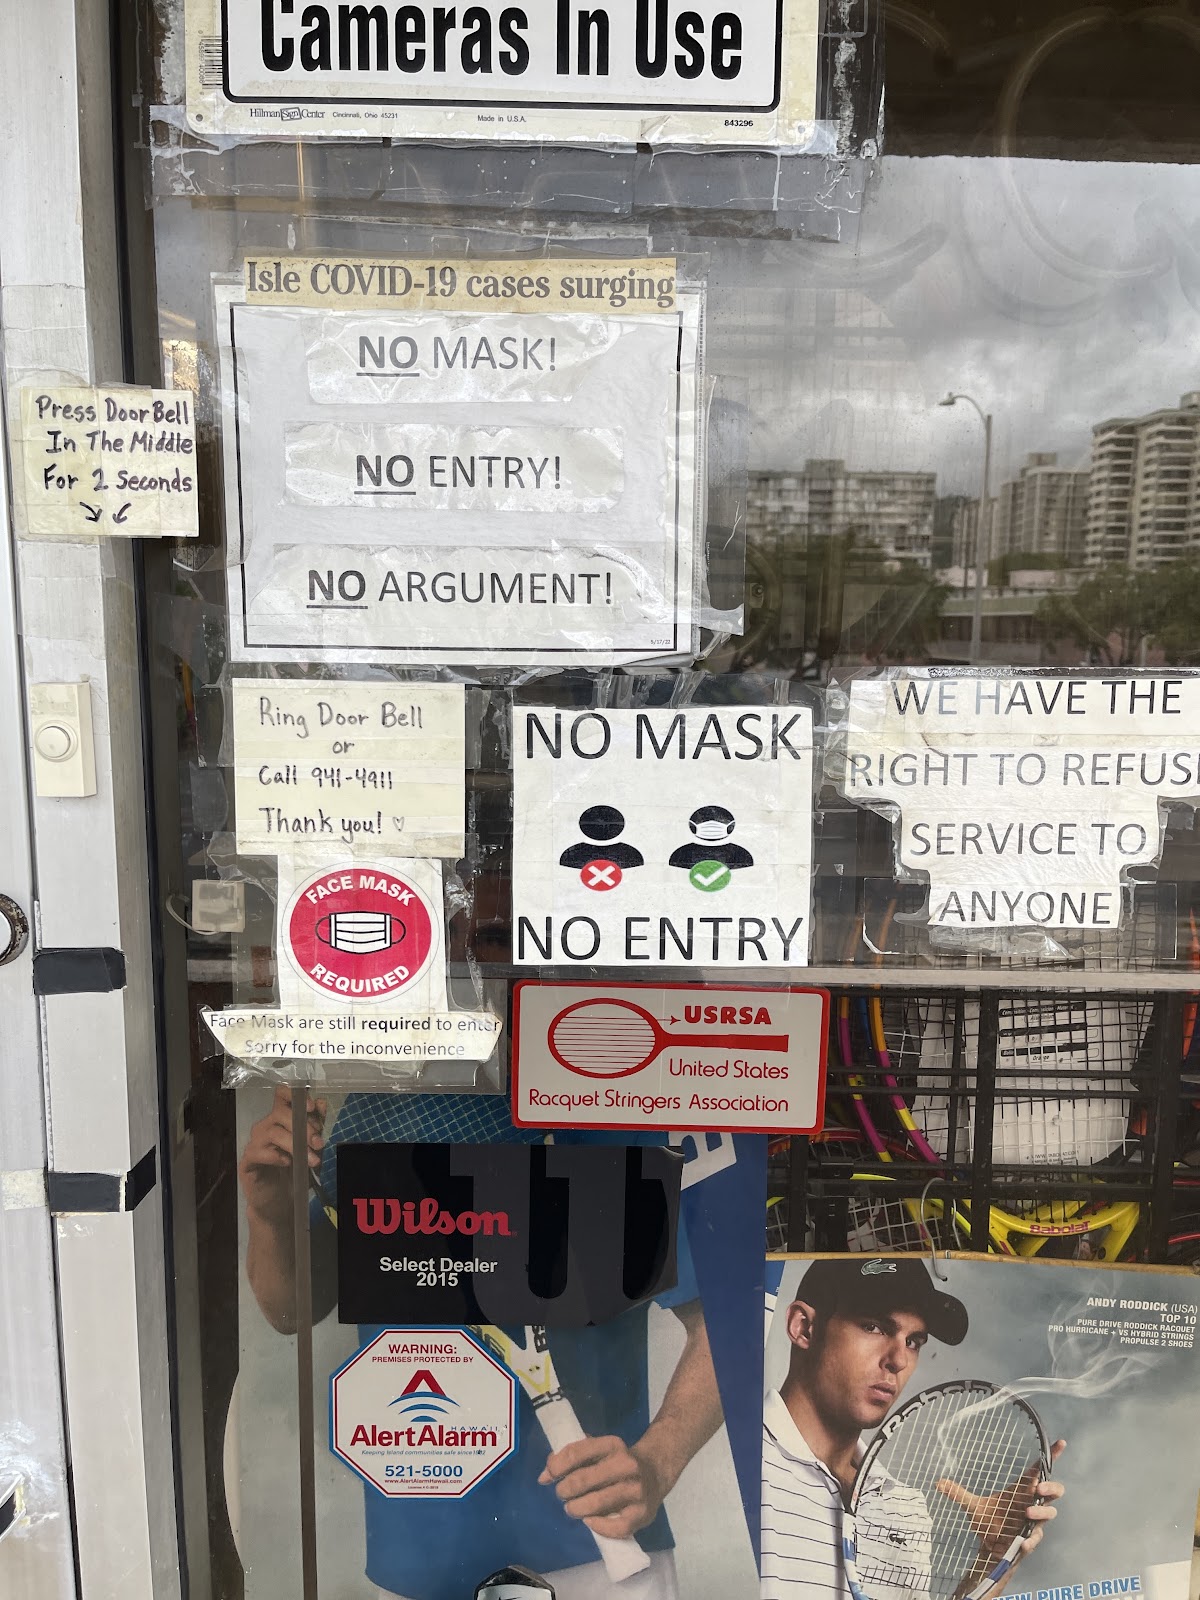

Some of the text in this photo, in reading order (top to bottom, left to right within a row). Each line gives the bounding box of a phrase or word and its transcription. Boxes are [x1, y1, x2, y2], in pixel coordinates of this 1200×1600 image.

[261, 0, 743, 80] Cameras In Use
[250, 108, 326, 120] Hillman Sign Center
[247, 261, 676, 309] Isle COVID-19 cases surging
[357, 335, 556, 372] NO MASK!
[35, 394, 189, 425] Press Door Bell
[45, 430, 193, 454] In The Middle
[43, 463, 193, 494] For 2 Seconds
[356, 454, 562, 490] NO ENTRY!
[307, 569, 612, 605] NO ARGUMENT!
[891, 680, 1184, 715] WE HAVE THE
[259, 696, 424, 739] Ring Door Bell
[332, 740, 355, 754] or
[525, 712, 802, 760] NO MASK
[258, 765, 394, 790] Call 941-4911
[850, 752, 1200, 787] RIGHT TO REFUS
[258, 807, 382, 844] Thank you!
[910, 822, 1147, 856] SERVICE TO
[305, 875, 416, 907] FACE MASK
[938, 890, 1112, 925] ANYONE
[517, 916, 804, 962] NO ENTRY
[309, 962, 411, 994] REQUIRED
[210, 1014, 500, 1033] Face Mask are still required to enter
[684, 1005, 772, 1026] USRSA
[245, 1040, 465, 1056] Sorry for the inconvenience
[669, 1058, 789, 1080] United States
[529, 1088, 789, 1114] Racquet Stringers Association
[352, 1197, 512, 1236] Wilson
[379, 1256, 498, 1273] Select Dealer
[416, 1272, 459, 1287] 2015
[1087, 1297, 1198, 1314] ANDY RODDICK (USA)
[1077, 1318, 1196, 1334] PURE DRIVE RODDICK RACQUET
[1160, 1313, 1197, 1325] TOP 10
[1065, 1325, 1109, 1335] HURRICANE
[1130, 1330, 1159, 1339] HYBRID
[1161, 1332, 1195, 1341] STRINGS
[1120, 1336, 1159, 1346] PROPULSE
[1168, 1339, 1194, 1348] SHOES
[388, 1344, 457, 1355] WARNING:
[385, 1465, 463, 1477] 521-5000
[1037, 1584, 1083, 1600] PURE
[1088, 1575, 1141, 1598] DRIVE
